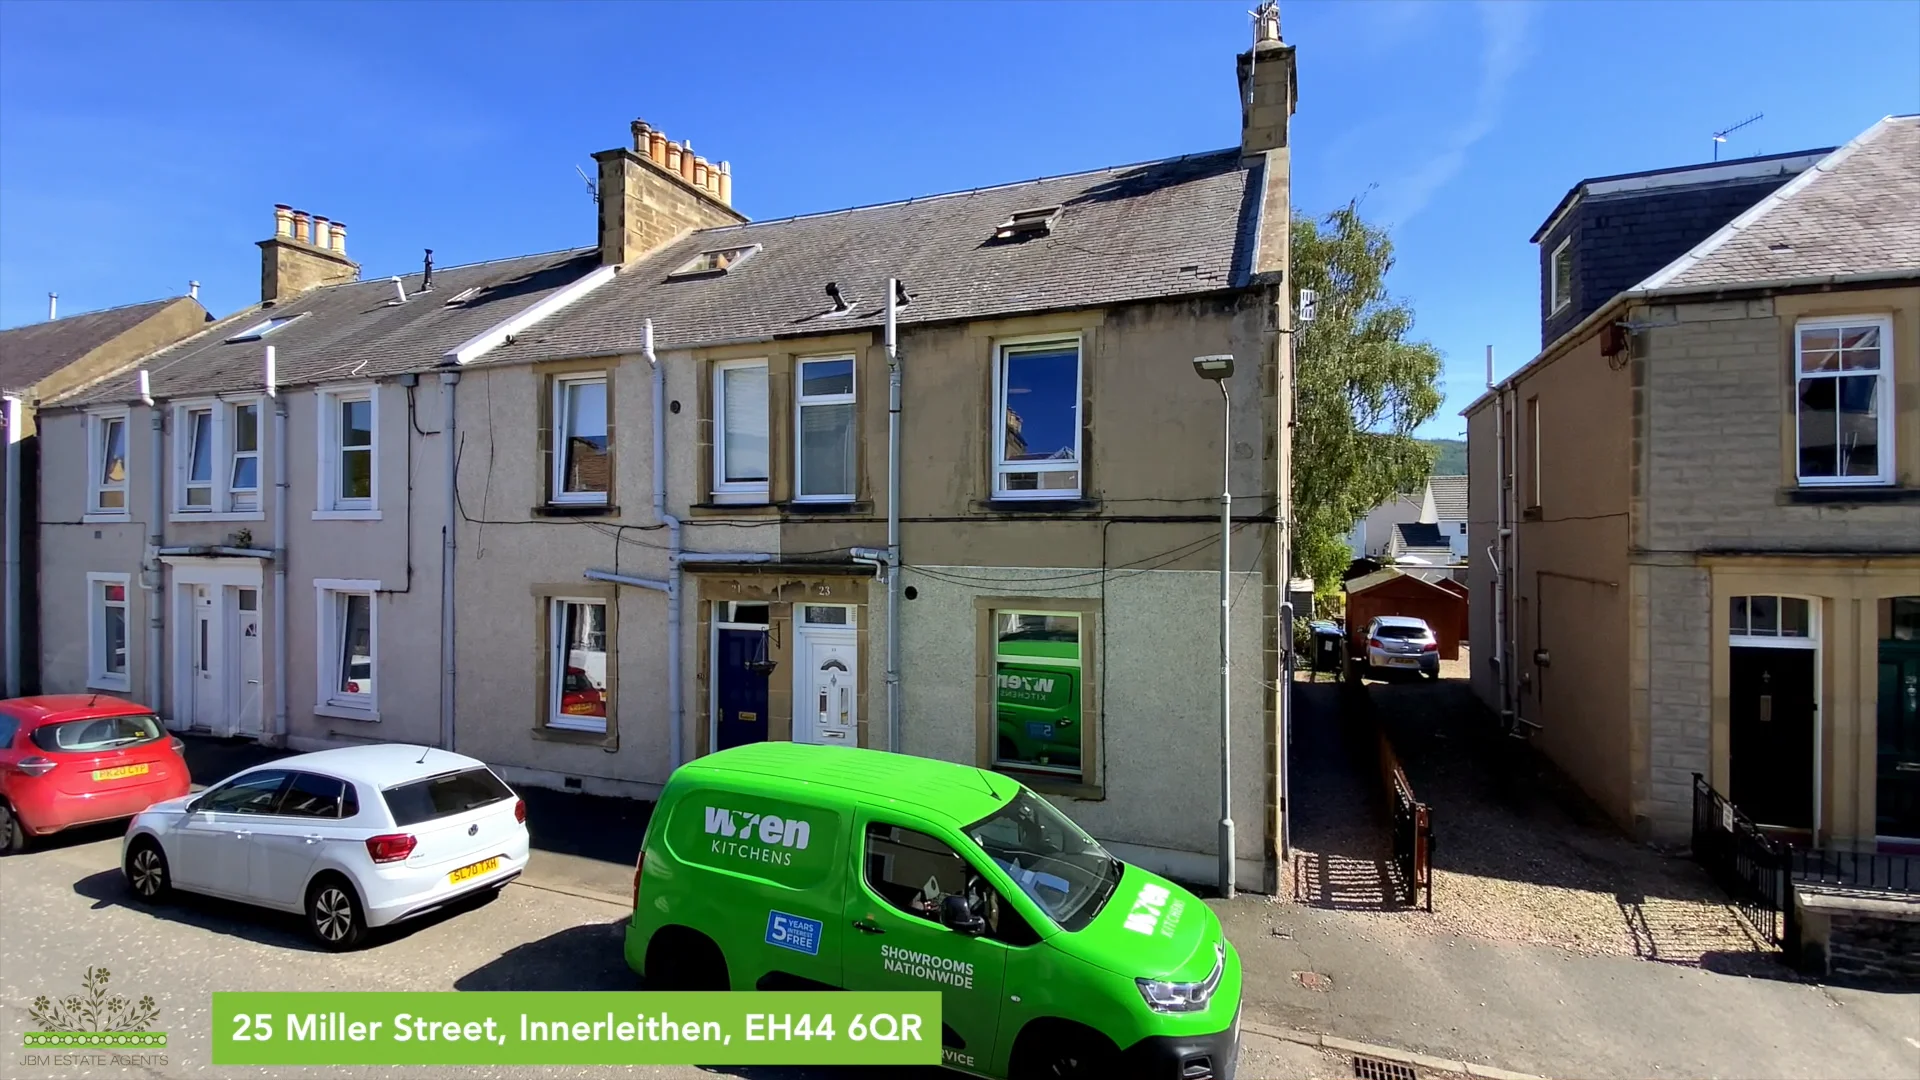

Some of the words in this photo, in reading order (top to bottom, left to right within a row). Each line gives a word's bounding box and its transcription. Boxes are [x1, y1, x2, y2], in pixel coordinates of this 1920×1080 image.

[818, 586, 831, 596] 23
[705, 806, 810, 850] wren
[711, 839, 792, 866] KITCHENS
[454, 866, 478, 881] SL70
[479, 858, 497, 872] TXH
[772, 916, 787, 940] 5
[787, 927, 813, 939] INTEREST
[788, 919, 814, 932] YEARS
[786, 933, 813, 949] FREE
[881, 944, 974, 976] SHOWROOMS
[884, 958, 973, 990] NATIONWIDE
